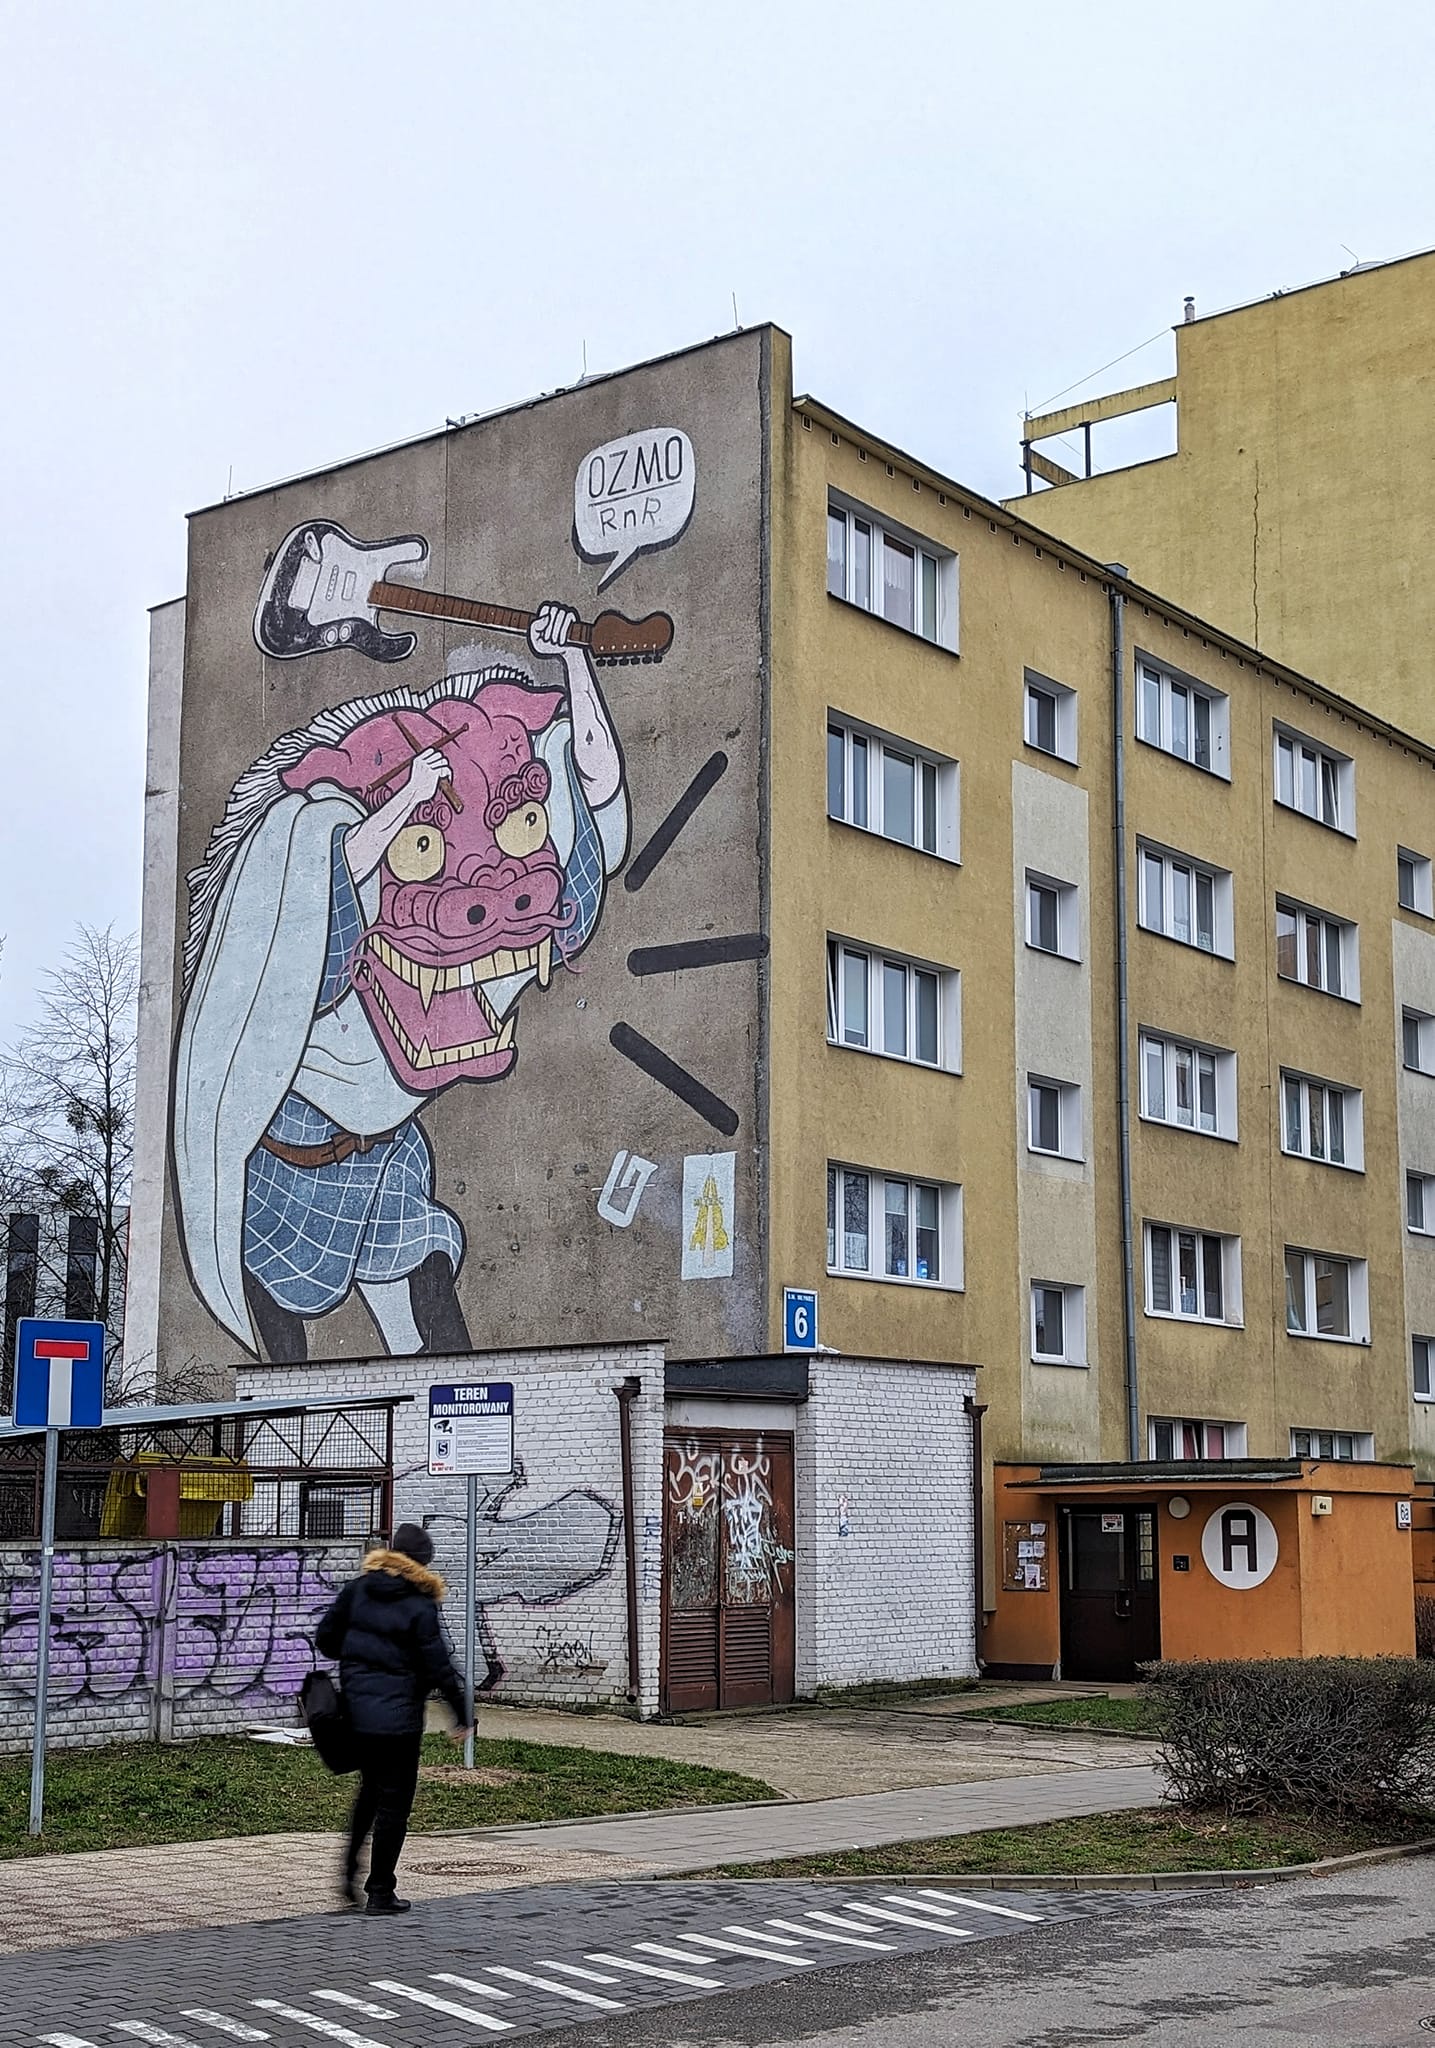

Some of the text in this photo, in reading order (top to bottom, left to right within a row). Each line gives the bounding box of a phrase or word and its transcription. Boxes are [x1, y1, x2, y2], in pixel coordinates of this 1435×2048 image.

[588, 436, 683, 498] OZMO
[795, 1306, 808, 1338] 6
[453, 1387, 488, 1400] TEREN
[433, 1402, 509, 1415] MONITOROWANY
[1400, 1503, 1409, 1521] 6a
[1221, 1509, 1258, 1572] A
